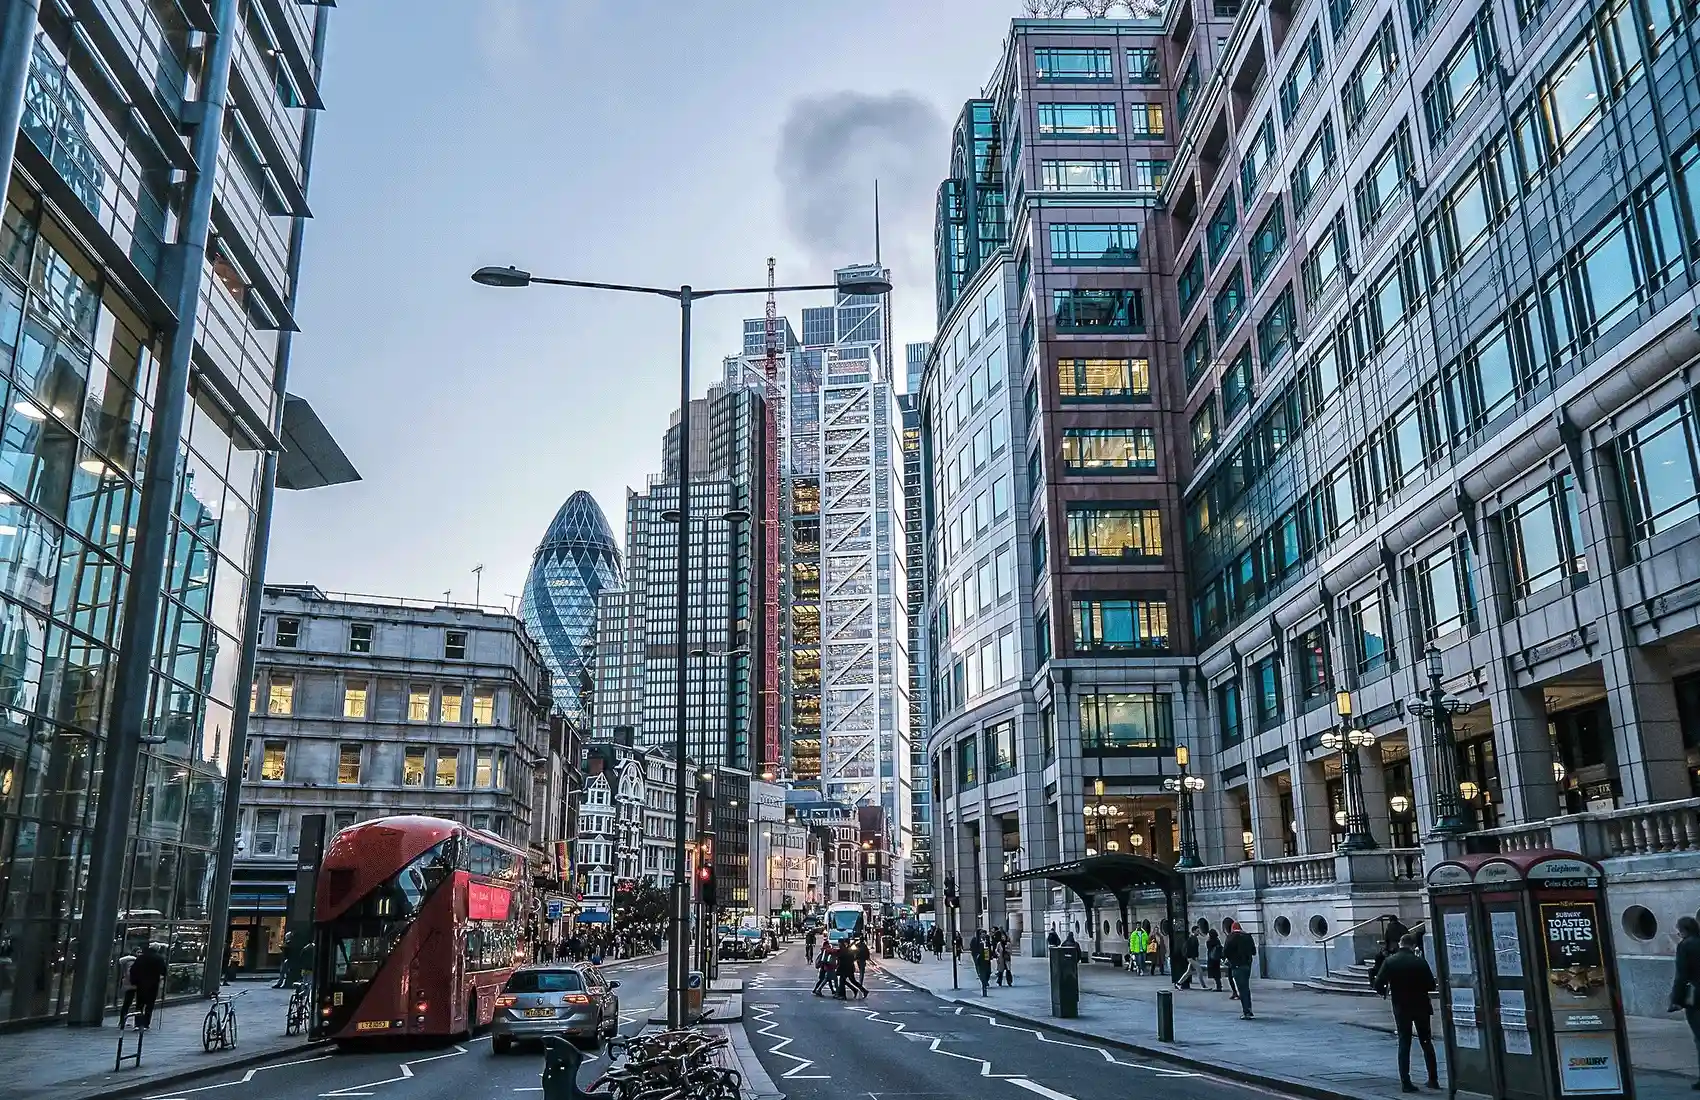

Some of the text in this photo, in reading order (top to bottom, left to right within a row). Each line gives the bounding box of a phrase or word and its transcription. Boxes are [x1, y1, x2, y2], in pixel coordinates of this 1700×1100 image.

[1545, 864, 1581, 874] Telephone
[378, 898, 390, 915] 11
[1548, 918, 1591, 928] TOASTED
[1550, 927, 1593, 941] BITES
[1568, 1056, 1609, 1067] SUBWAY
